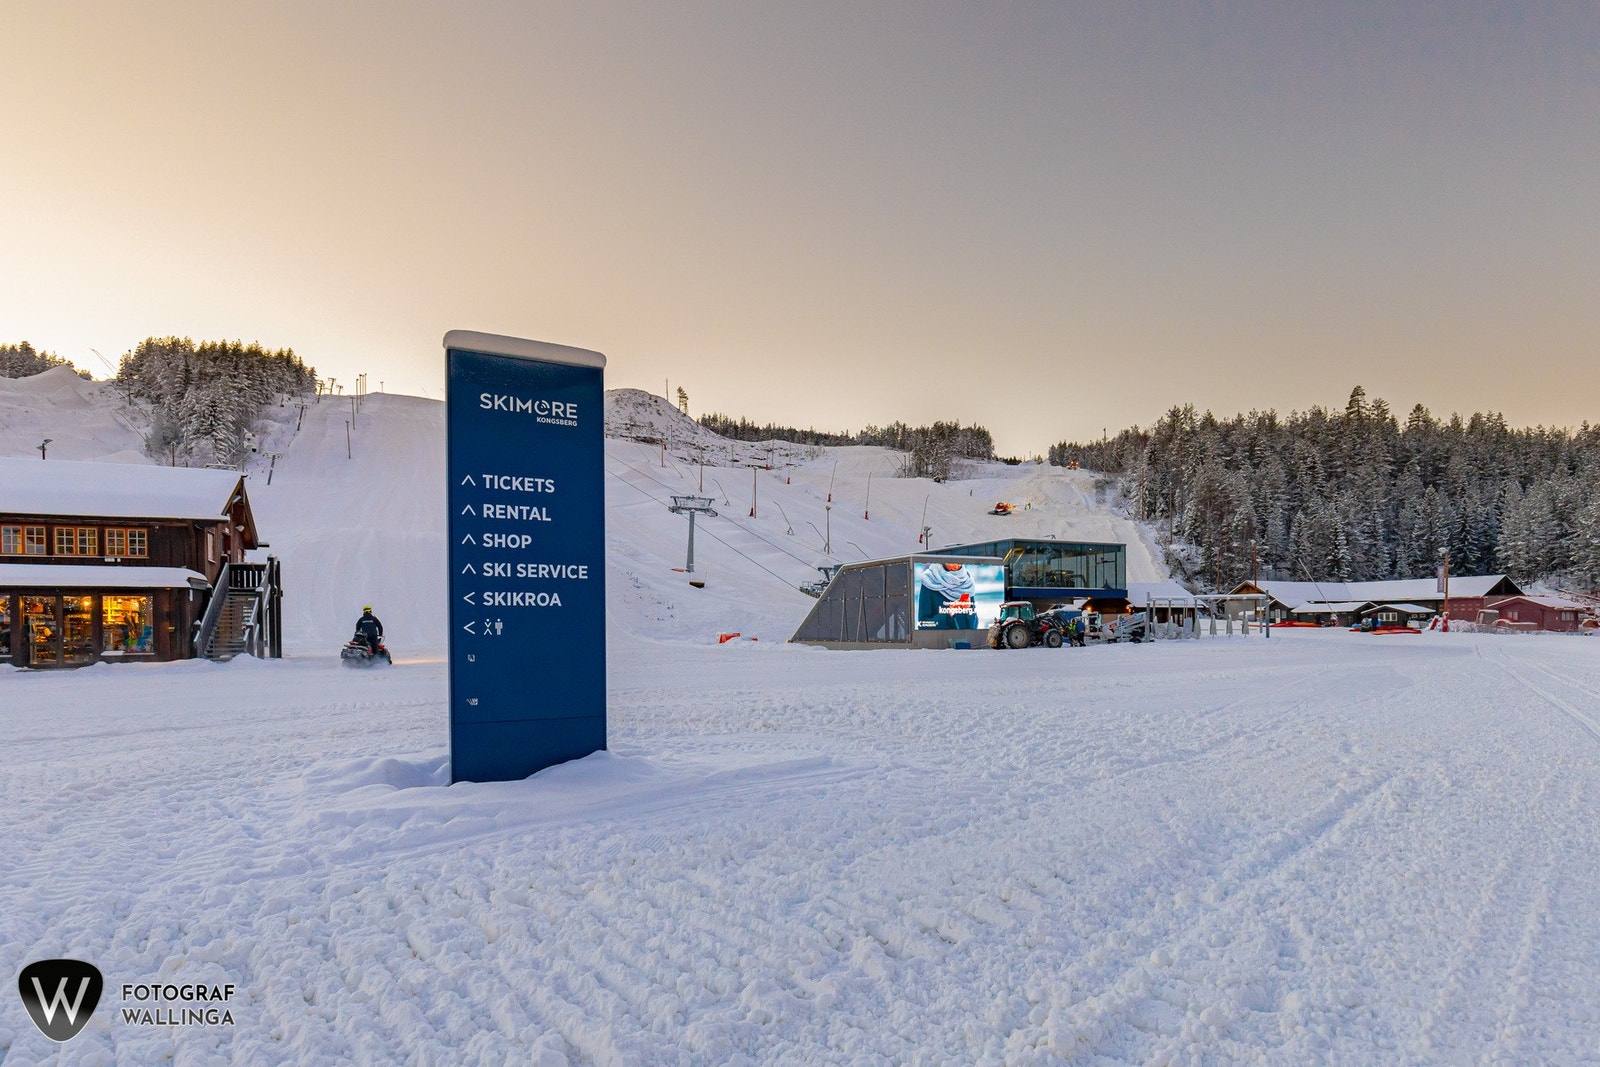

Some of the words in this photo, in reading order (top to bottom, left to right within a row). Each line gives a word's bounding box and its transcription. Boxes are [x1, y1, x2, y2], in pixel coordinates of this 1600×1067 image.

[480, 393, 578, 418] SKIMORE
[536, 416, 578, 427] KONGSBERG
[483, 475, 555, 493] TICKETS
[482, 504, 552, 522] RENTAL
[482, 533, 532, 549] SHOP
[482, 562, 512, 577] SKI
[516, 564, 588, 579] SERVICE
[482, 591, 562, 607] SKIKROA
